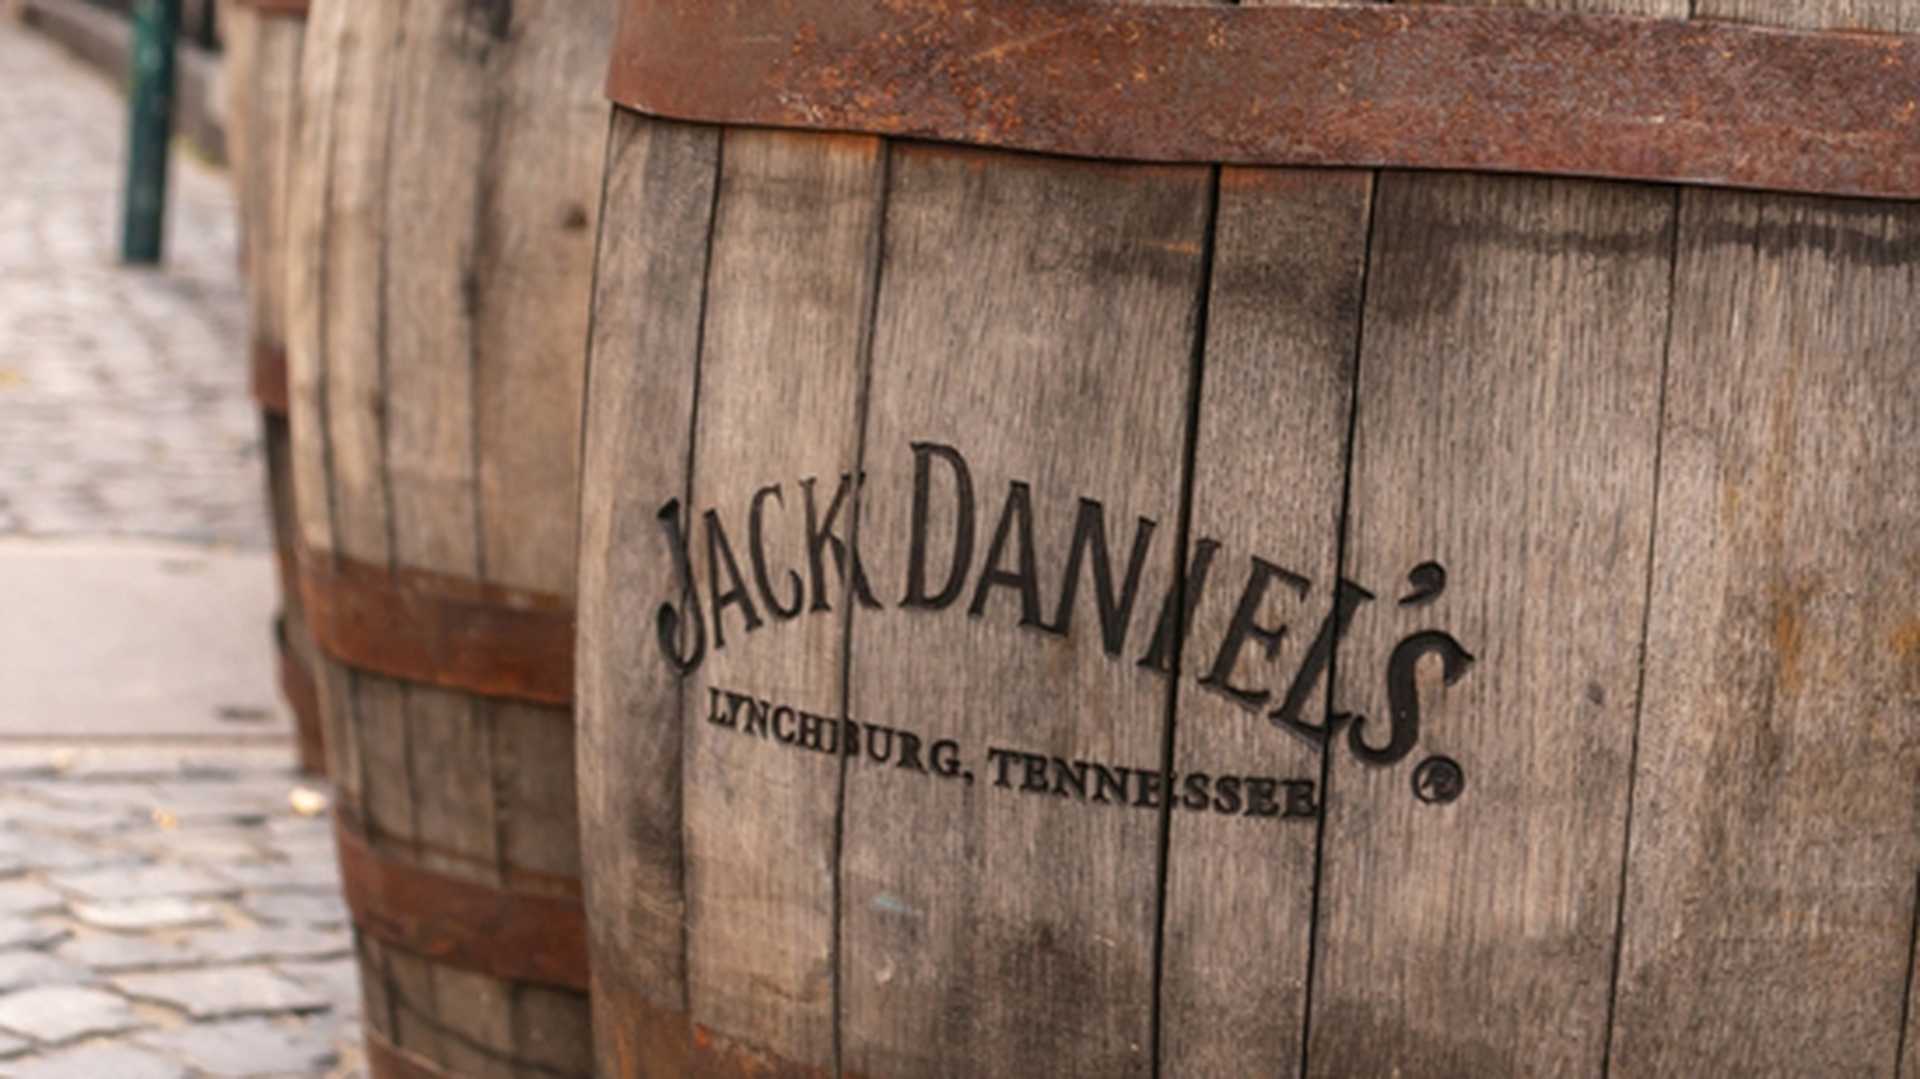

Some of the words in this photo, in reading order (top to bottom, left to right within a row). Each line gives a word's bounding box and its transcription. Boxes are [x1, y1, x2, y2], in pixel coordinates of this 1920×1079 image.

[656, 470, 884, 676] JACK
[898, 440, 1475, 765] DANIEL'S
[706, 686, 975, 787] LYNCHBURG,
[987, 746, 1321, 818] TENNESSEE
